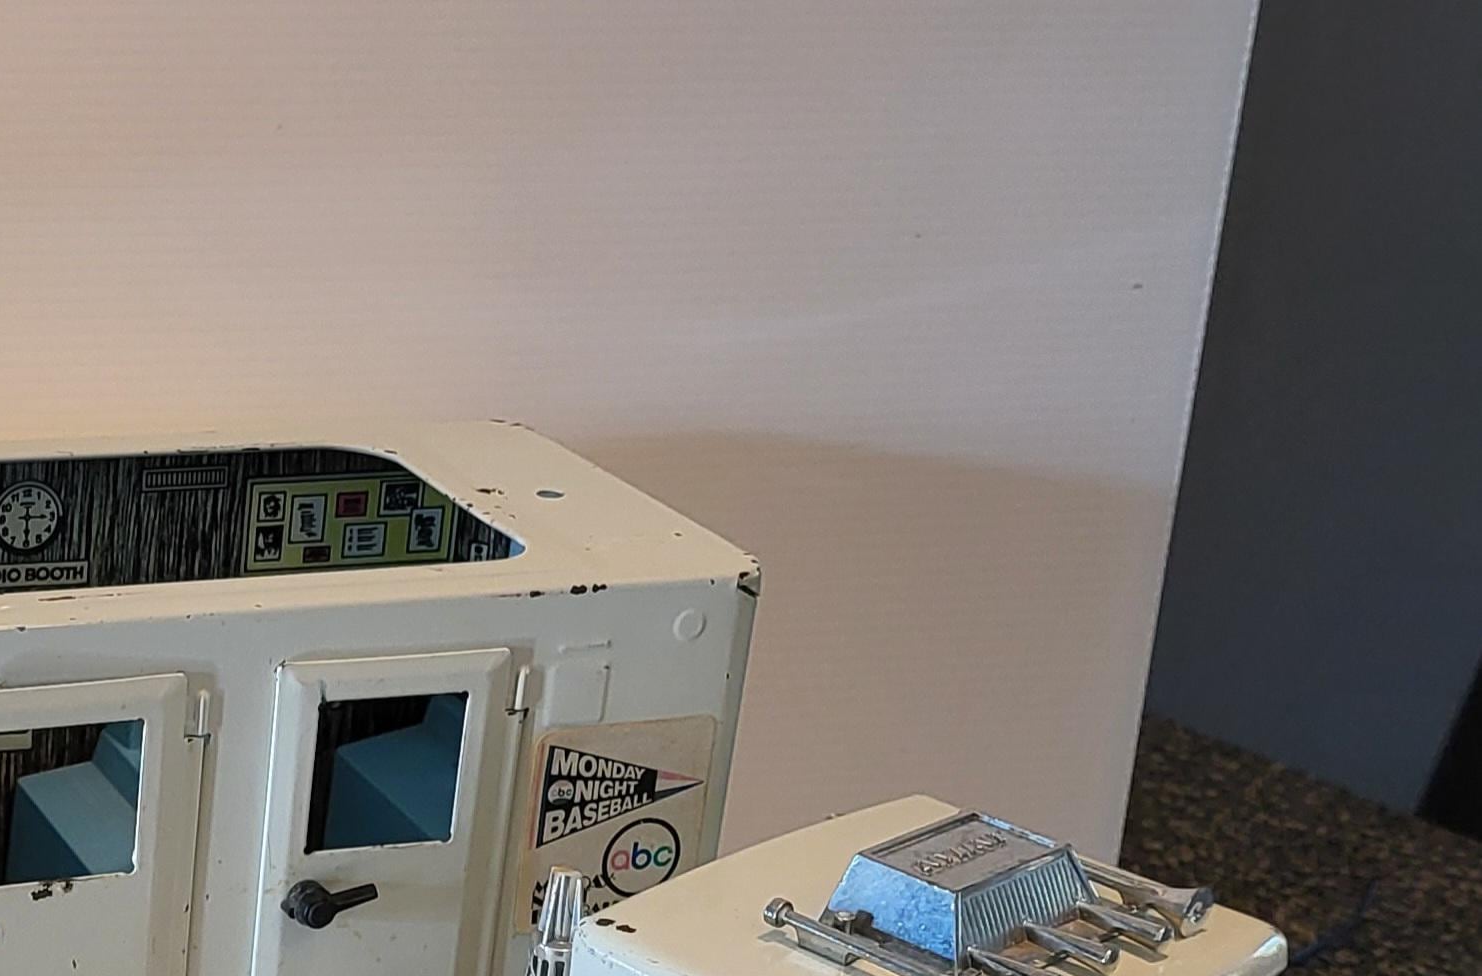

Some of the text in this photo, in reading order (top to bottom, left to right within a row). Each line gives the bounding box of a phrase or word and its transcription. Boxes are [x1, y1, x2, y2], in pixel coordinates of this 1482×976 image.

[24, 565, 84, 582] BOOTH
[551, 747, 646, 781] MONDAY
[573, 779, 639, 803] NIGHT
[542, 792, 653, 844] BASEBALL
[611, 842, 674, 871] abc
